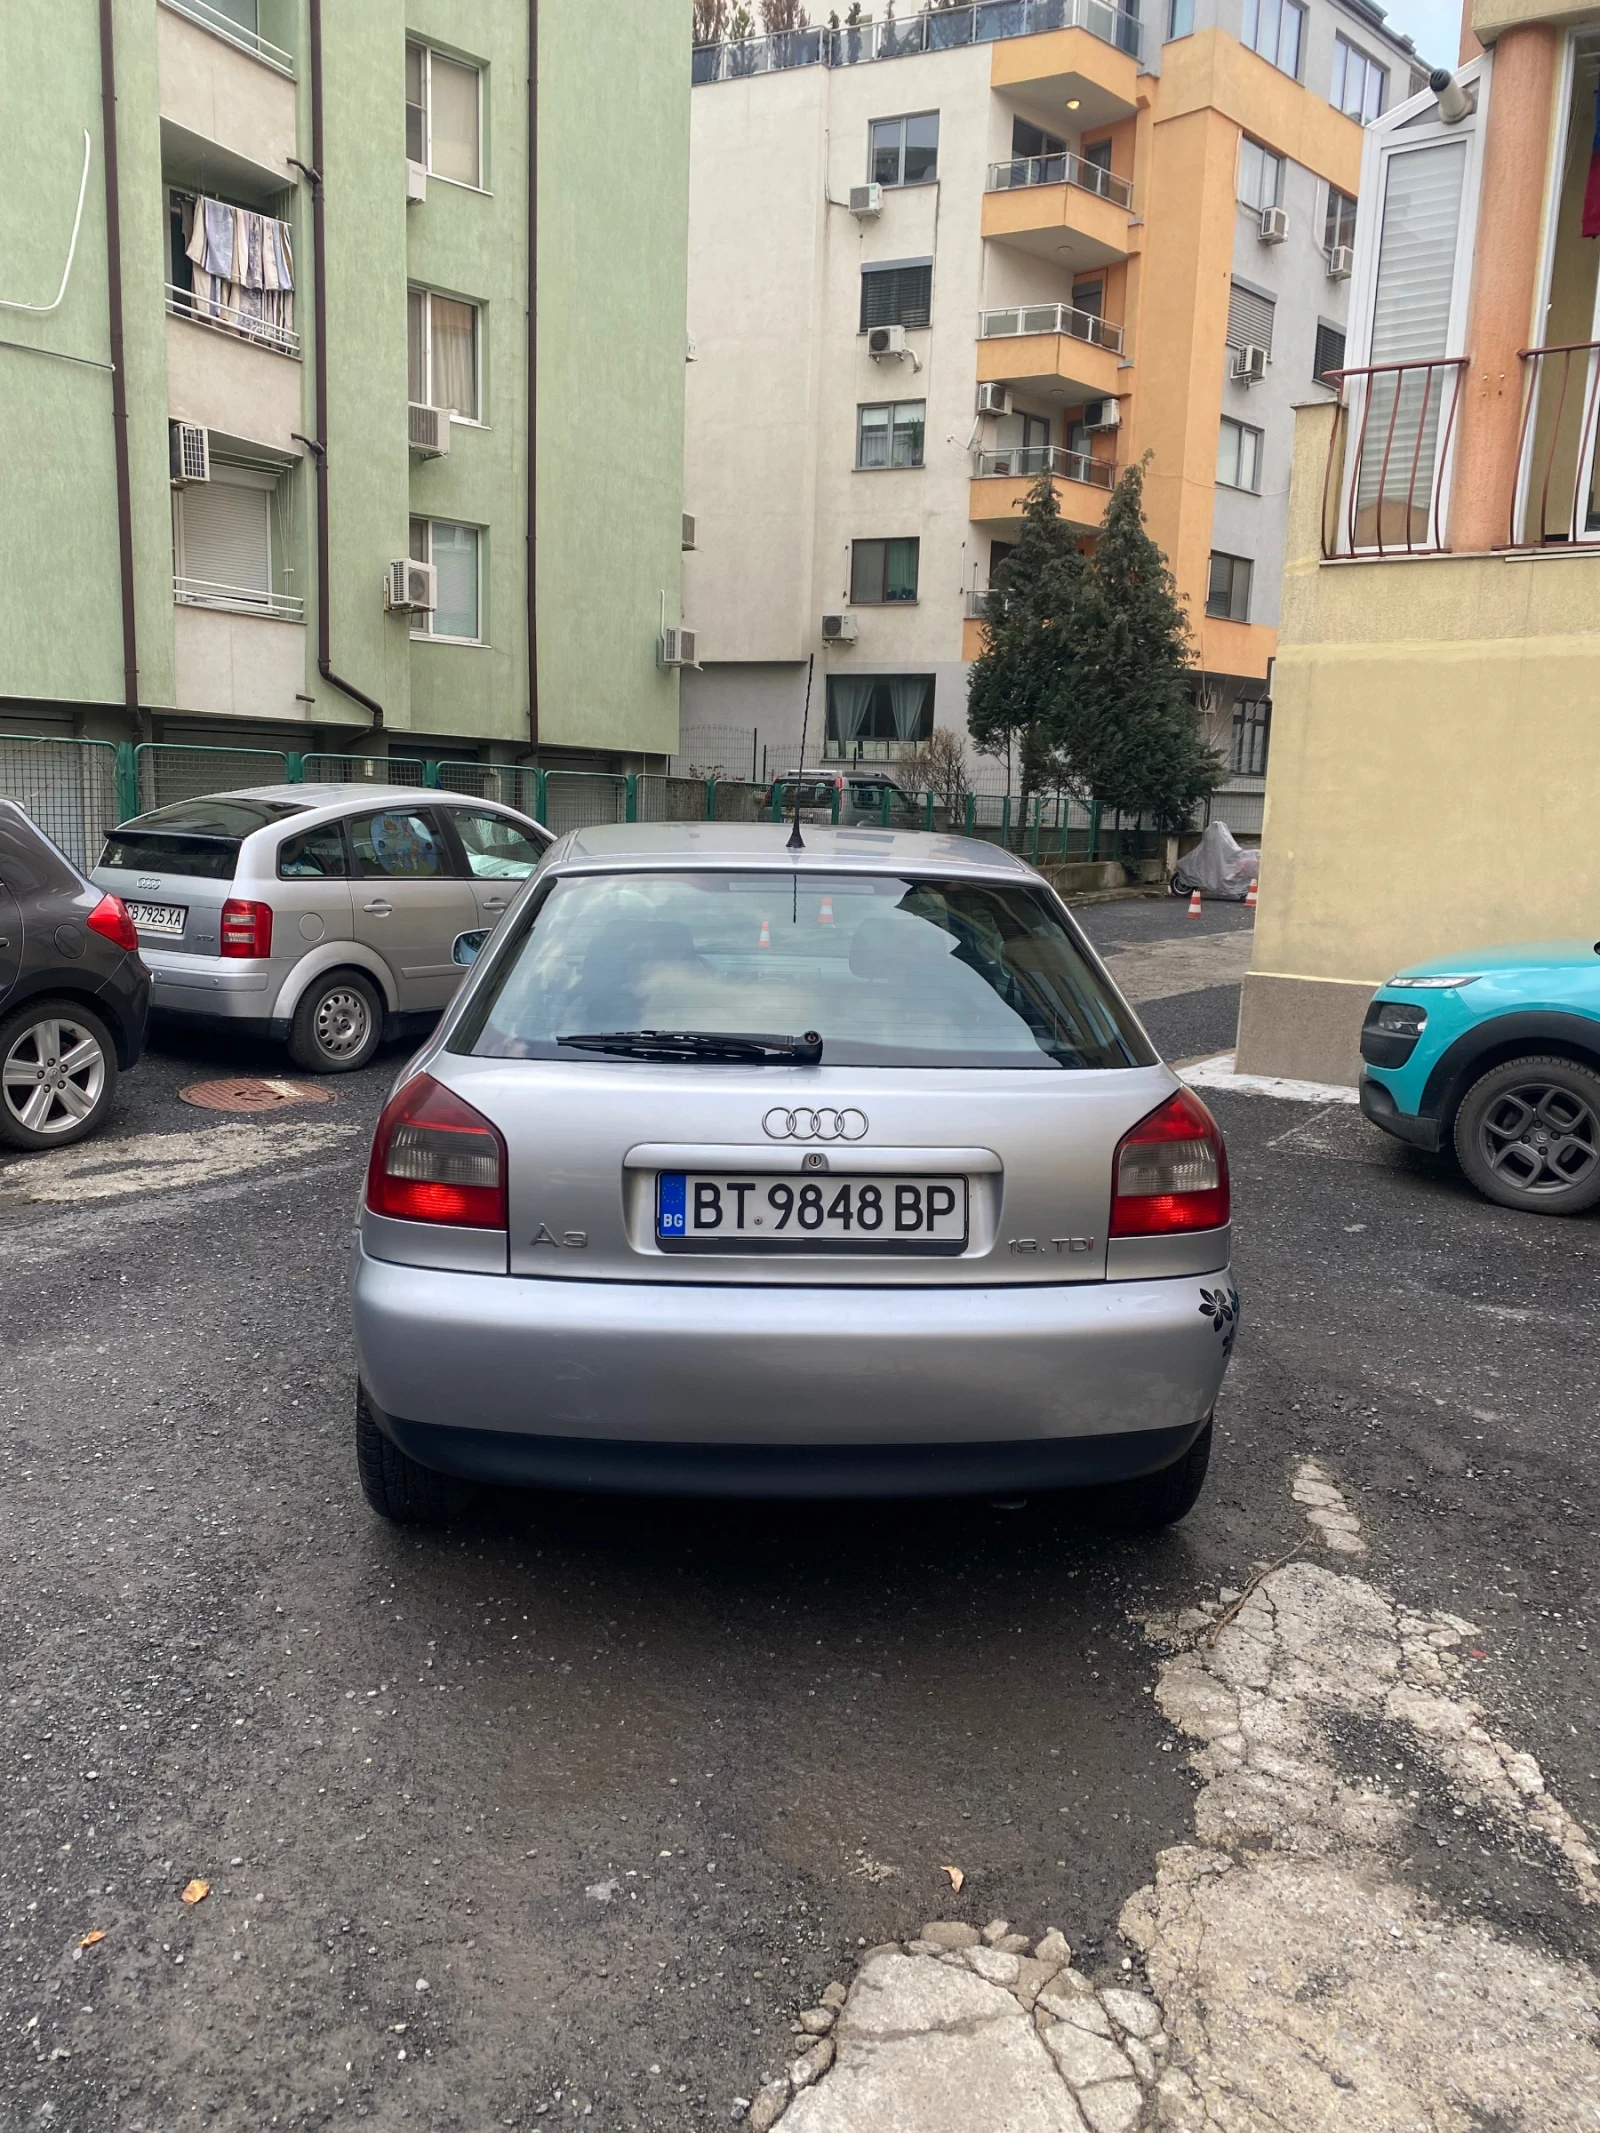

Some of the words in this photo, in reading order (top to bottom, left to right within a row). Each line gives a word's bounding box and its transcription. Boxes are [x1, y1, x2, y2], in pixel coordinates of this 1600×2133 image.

[139, 906, 166, 923] 7925
[166, 909, 181, 926] XA
[694, 1182, 756, 1229] BT
[767, 1183, 883, 1230] 9848
[895, 1185, 956, 1231] BP
[663, 1213, 684, 1227] BG
[529, 1222, 588, 1248] A3
